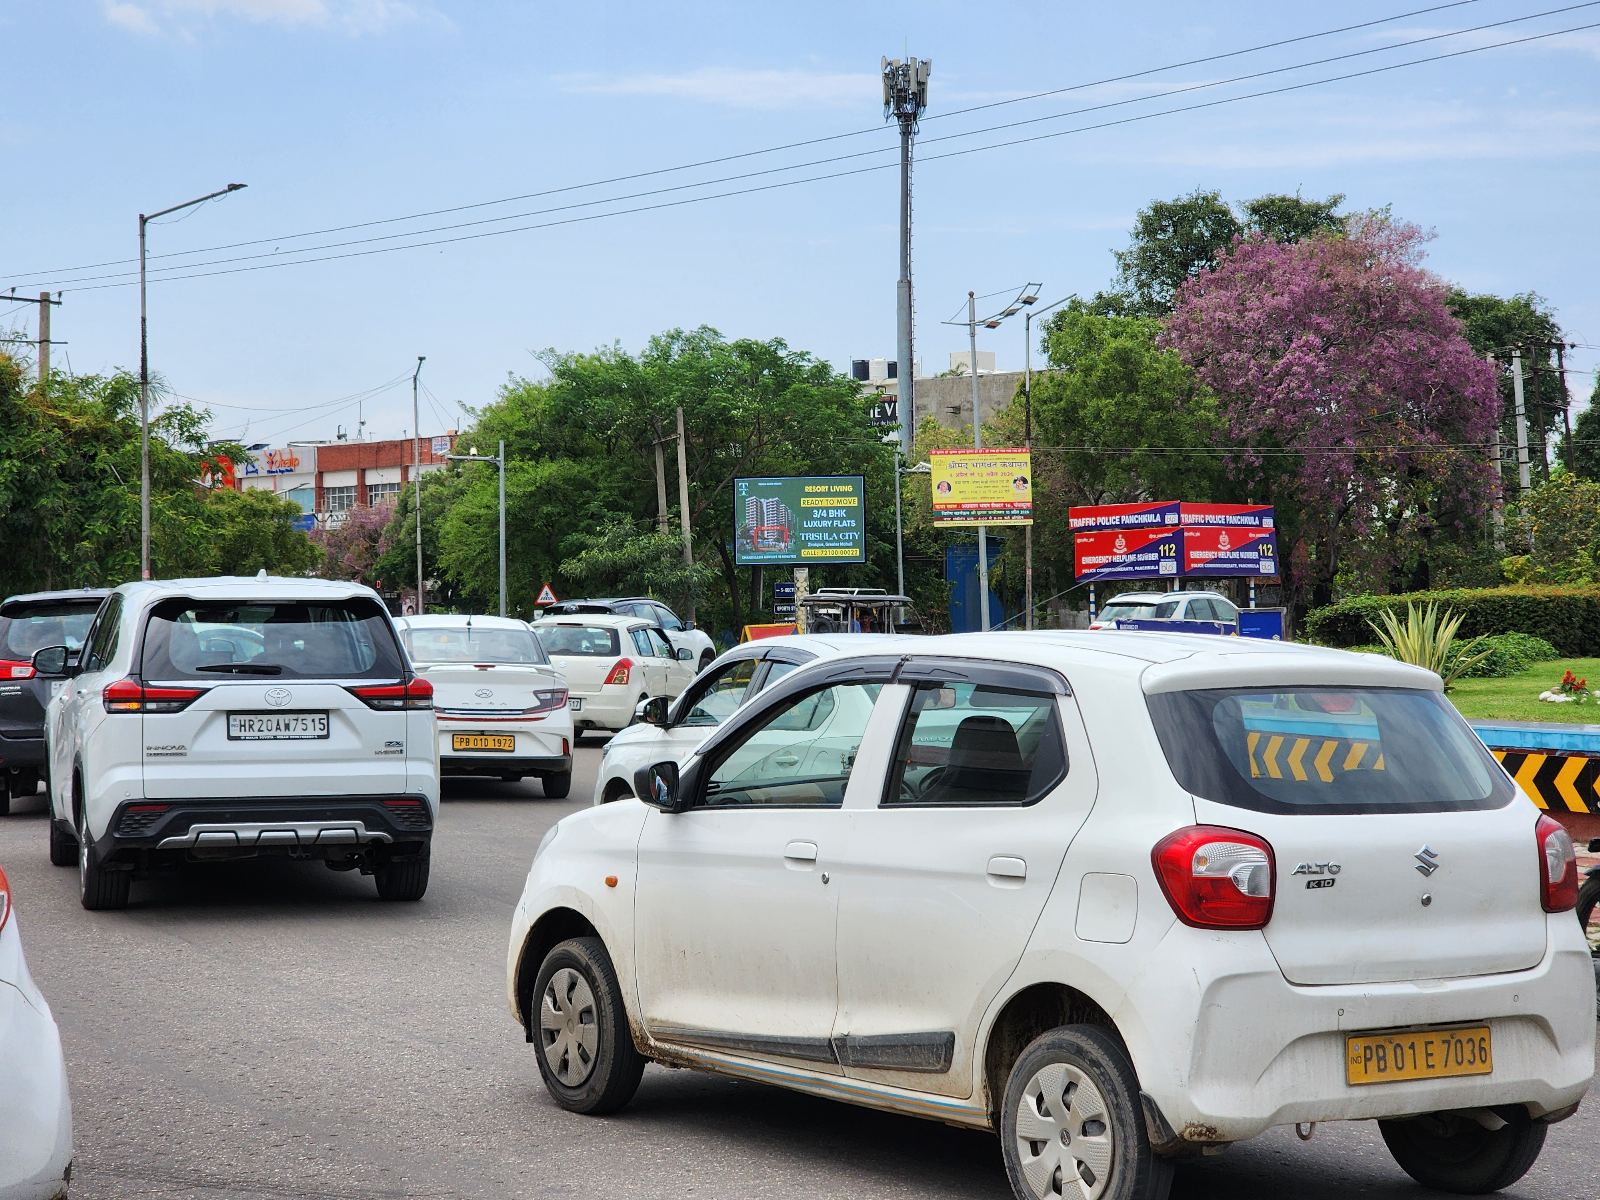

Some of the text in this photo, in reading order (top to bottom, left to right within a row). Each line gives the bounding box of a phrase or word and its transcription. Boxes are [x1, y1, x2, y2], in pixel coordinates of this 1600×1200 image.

[812, 509, 846, 518] 3/4 BHK
[1180, 513, 1205, 523] TRAFFIC
[1205, 514, 1225, 524] POLICE
[1226, 515, 1259, 525] PANCHKULA
[803, 520, 832, 528] LUXURY
[1069, 517, 1096, 527] TRAFFIC
[1097, 515, 1120, 526] POLICE
[1121, 513, 1161, 524] PANCHKULA
[800, 531, 860, 540] TRISHLA CITY
[1159, 543, 1176, 557] 112
[1190, 551, 1259, 559] EMERGENCY HELPLINE NUMBER
[1258, 543, 1273, 556] 112
[1081, 553, 1159, 564] EMERGENCY HELPLINE NUMBER
[239, 717, 326, 733] HR20AW7515
[459, 737, 470, 747] PB
[492, 738, 513, 748] 1972
[1291, 861, 1342, 876] ALTO
[1308, 879, 1334, 889] K10
[1364, 1036, 1488, 1074] PB 01 E 7036
